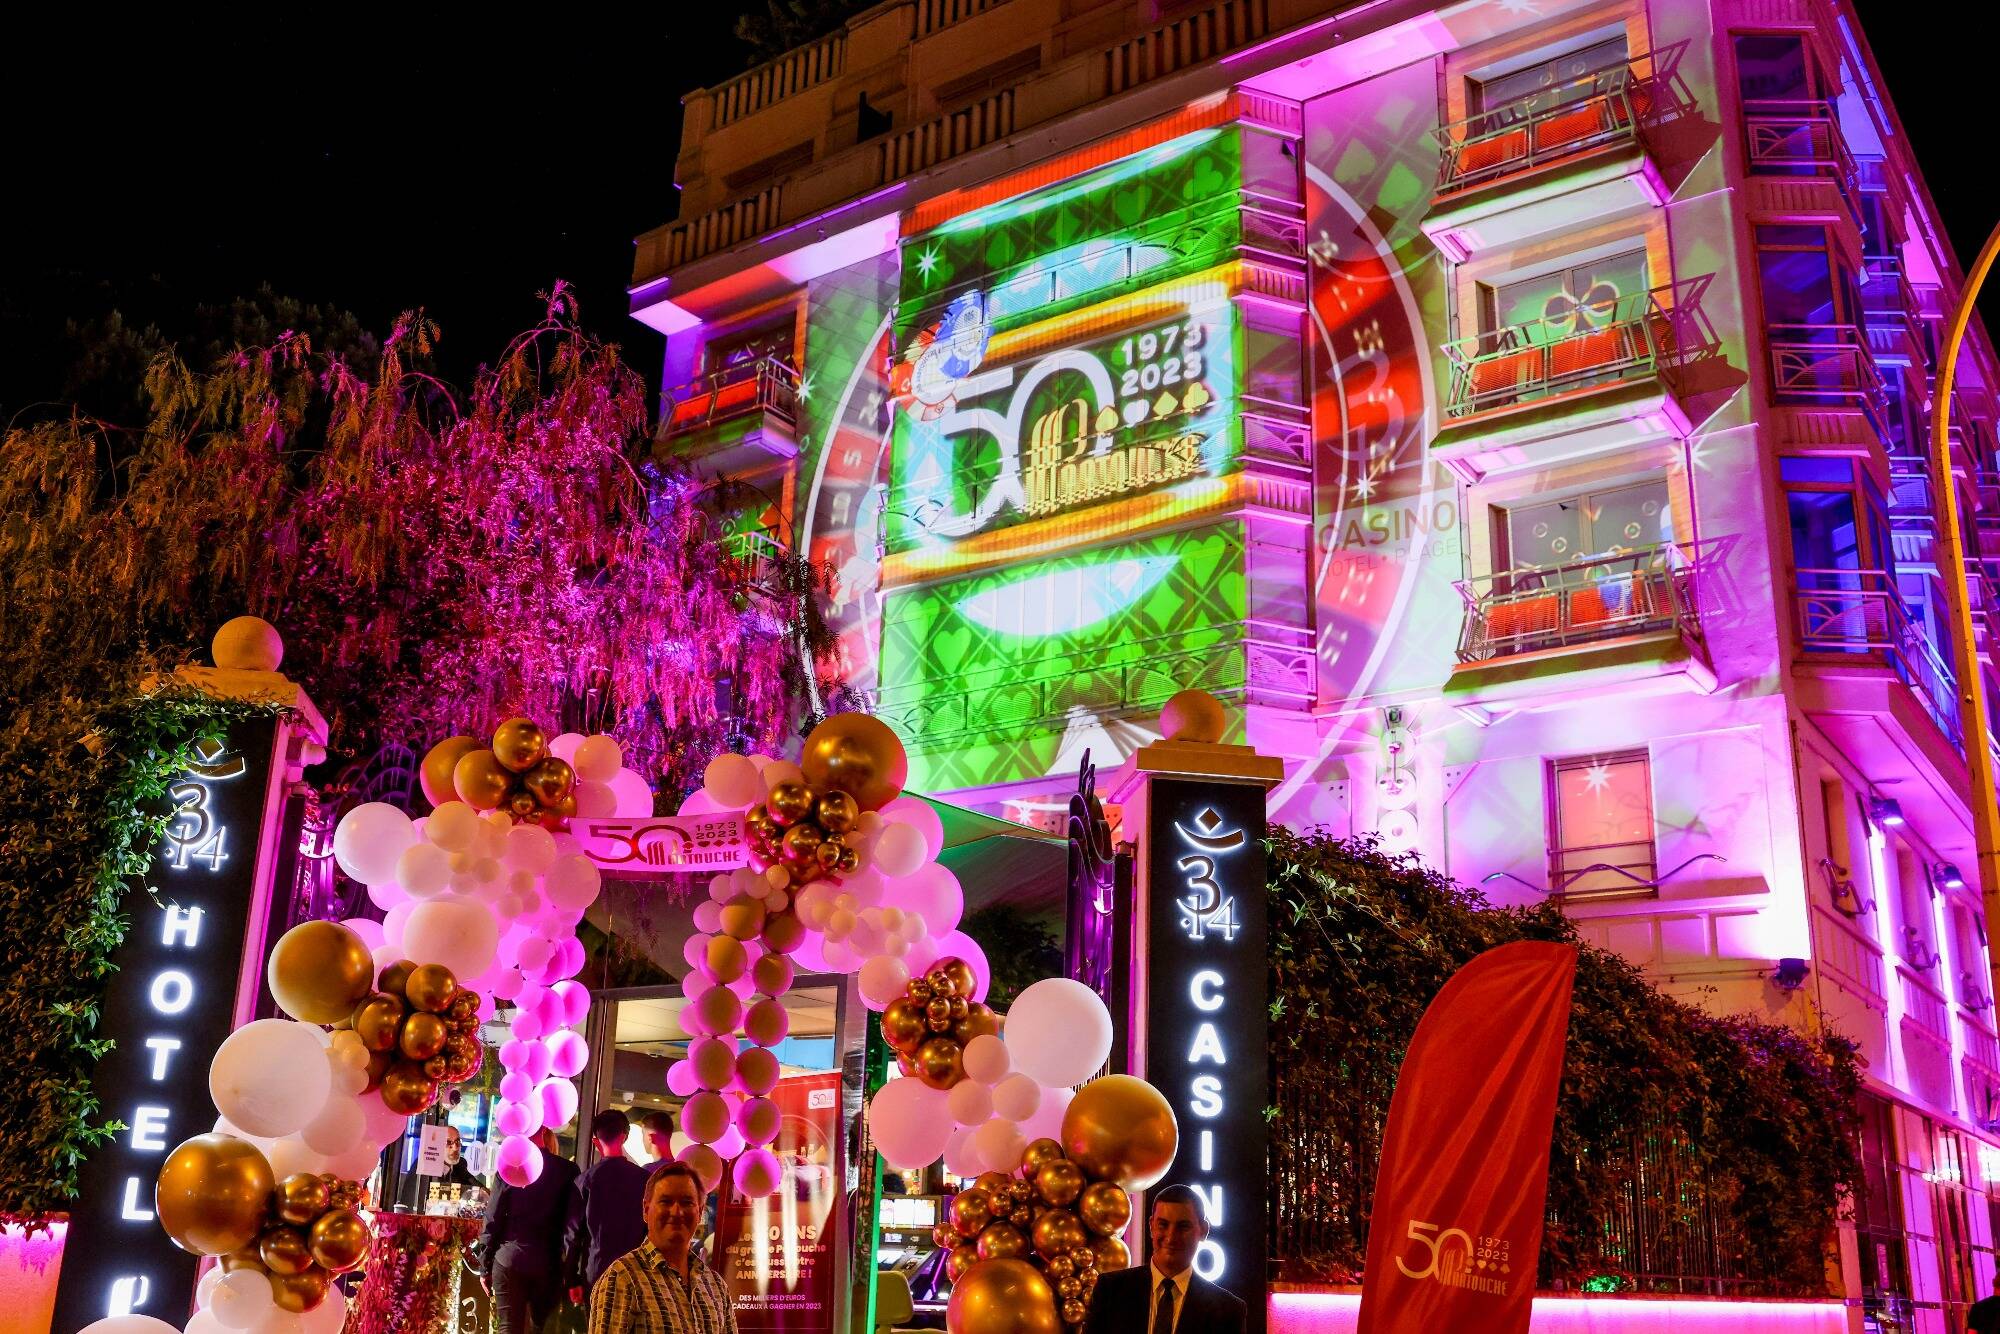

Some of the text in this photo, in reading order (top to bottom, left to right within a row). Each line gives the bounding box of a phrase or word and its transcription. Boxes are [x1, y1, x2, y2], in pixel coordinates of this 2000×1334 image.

[1121, 319, 1202, 365] 1973
[1121, 352, 1202, 397] 2023
[922, 350, 1114, 537] 50
[1319, 500, 1456, 554] CASINO
[584, 825, 693, 864] 50
[695, 821, 737, 832] 1973
[695, 829, 738, 840] 2023
[121, 904, 202, 1221] HOTEL
[1188, 970, 1227, 1283] CASINO
[1396, 1219, 1474, 1280] 50
[1476, 1247, 1509, 1261] 2023
[1478, 1235, 1510, 1250] 1973
